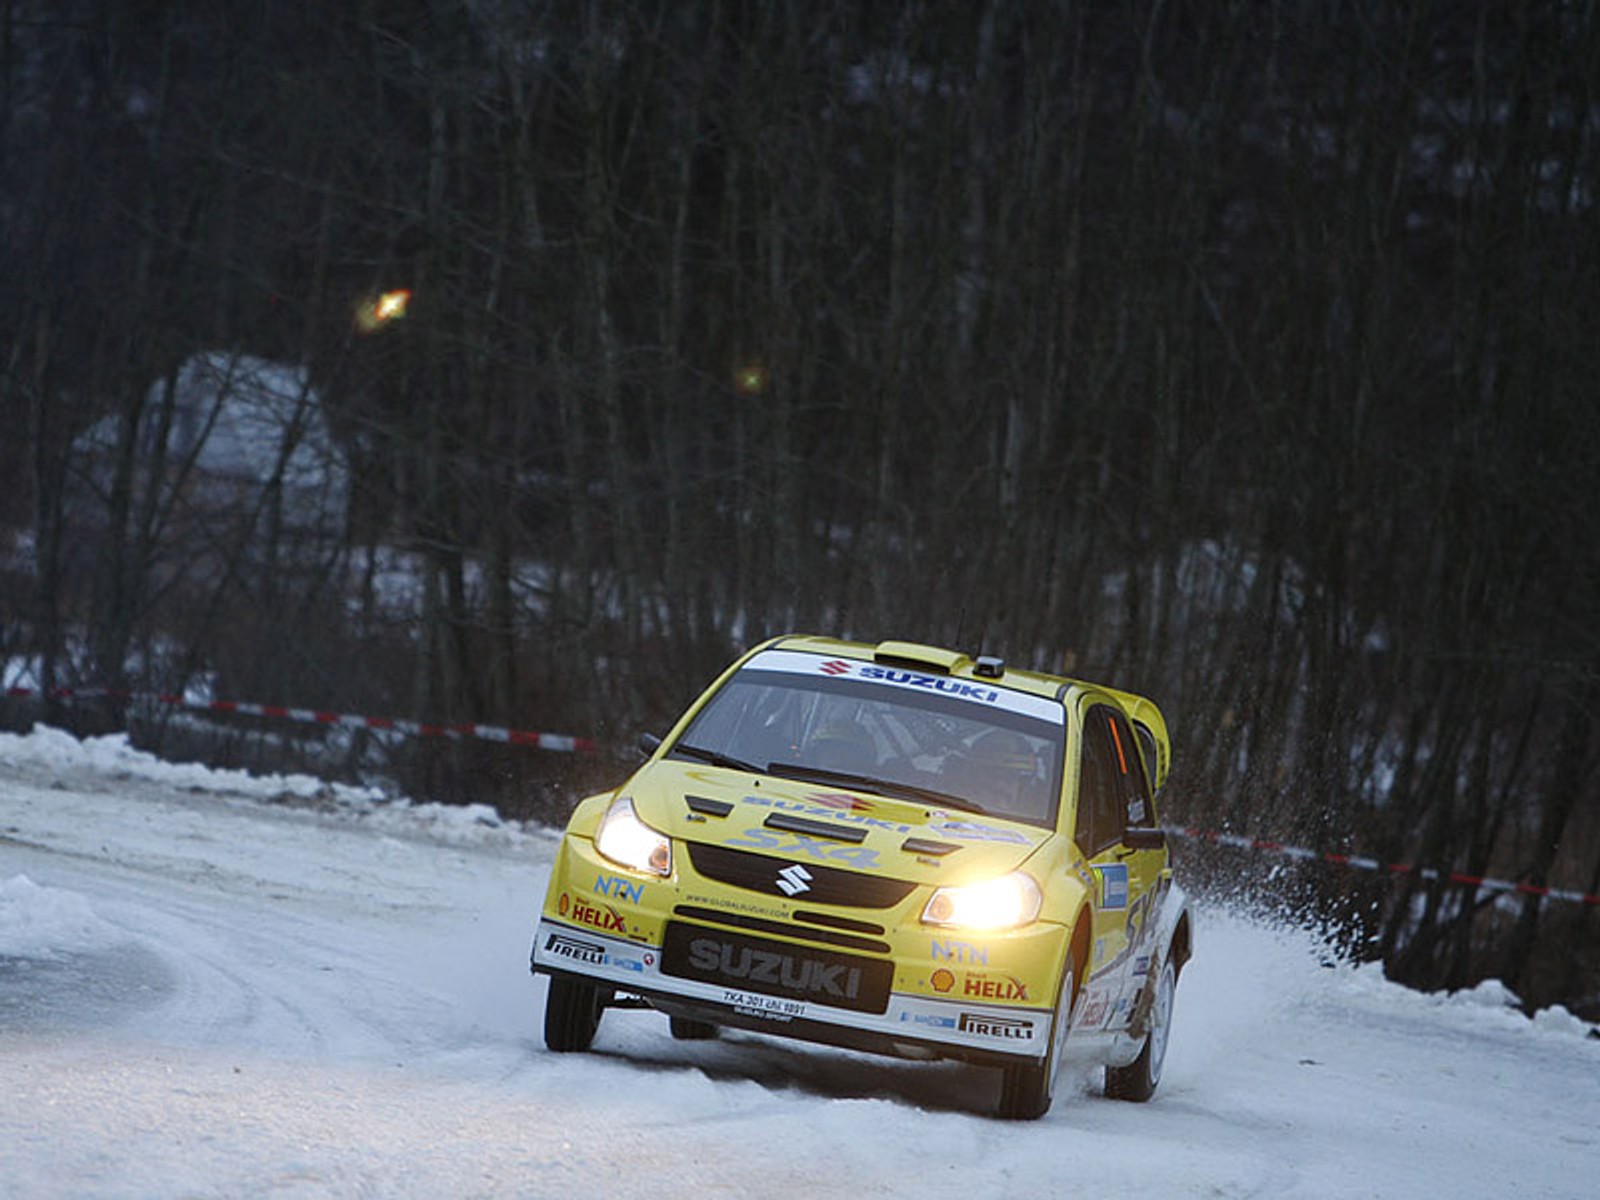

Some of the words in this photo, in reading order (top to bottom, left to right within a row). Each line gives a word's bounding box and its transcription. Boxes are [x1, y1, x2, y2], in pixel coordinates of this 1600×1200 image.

[859, 666, 998, 702] SUZUKI
[742, 796, 911, 833] SUZUKI
[724, 829, 881, 869] SX4
[593, 875, 645, 905] NTN
[572, 904, 626, 933] HELIX
[544, 933, 605, 965] PIRELLI
[931, 940, 989, 966] NTN
[689, 938, 863, 998] SUZUKI
[963, 976, 1029, 1001] HELIX
[958, 1012, 1034, 1039] PIRELLI
